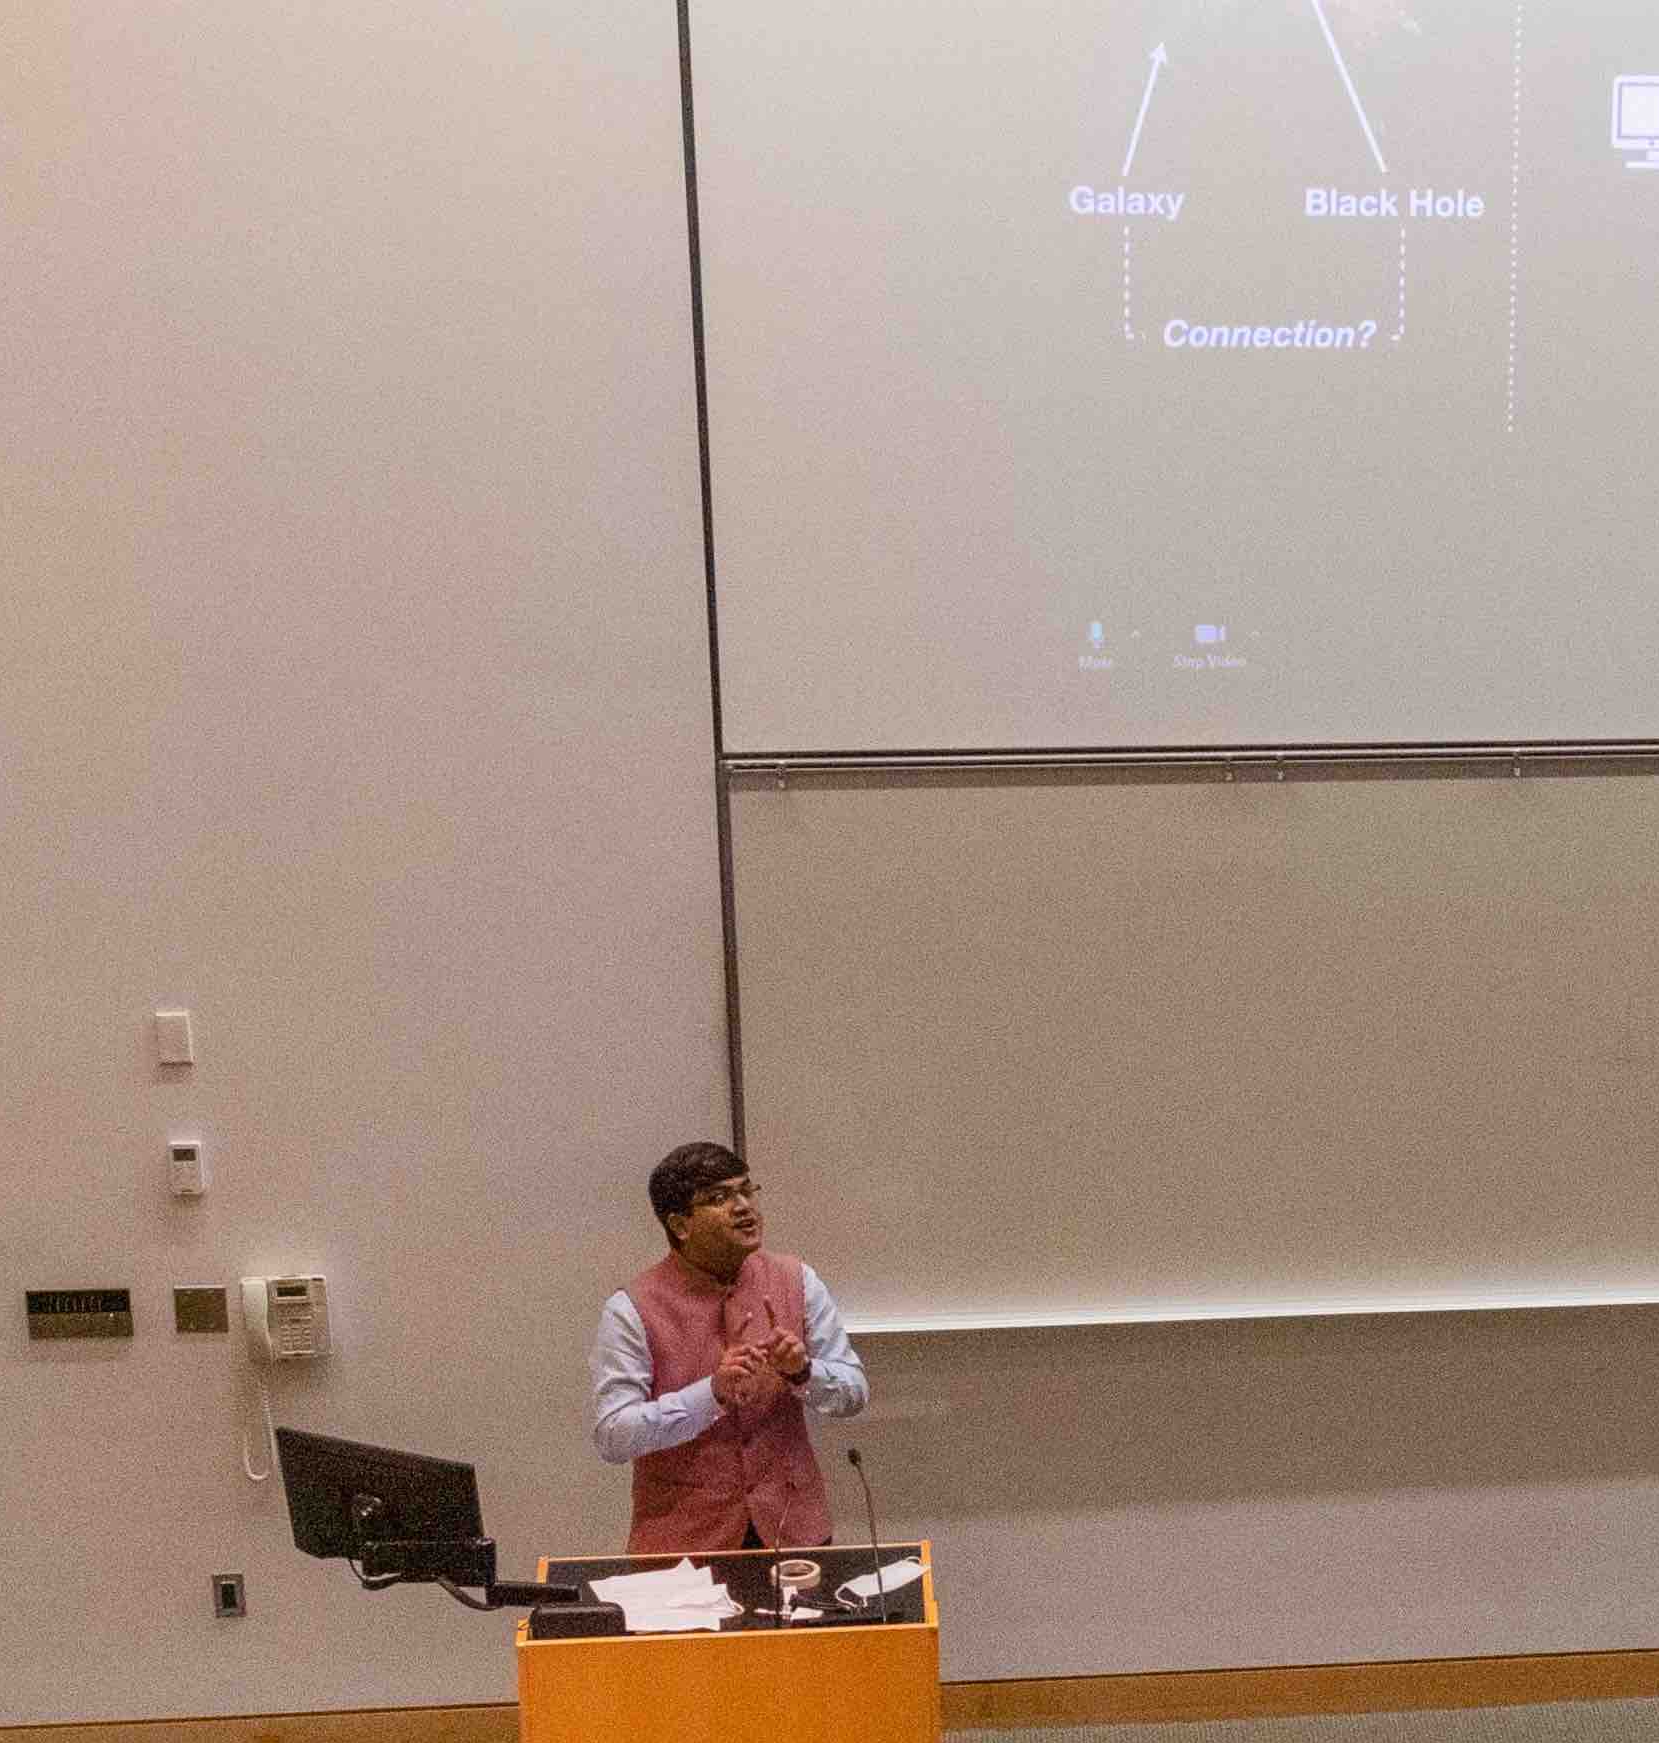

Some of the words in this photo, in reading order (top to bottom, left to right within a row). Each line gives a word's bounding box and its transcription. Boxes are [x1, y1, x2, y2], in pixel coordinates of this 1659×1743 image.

[1069, 185, 1185, 222] Galaxy
[1304, 187, 1398, 218] Black
[1409, 188, 1485, 218] Hole
[1163, 319, 1378, 351] Connection?
